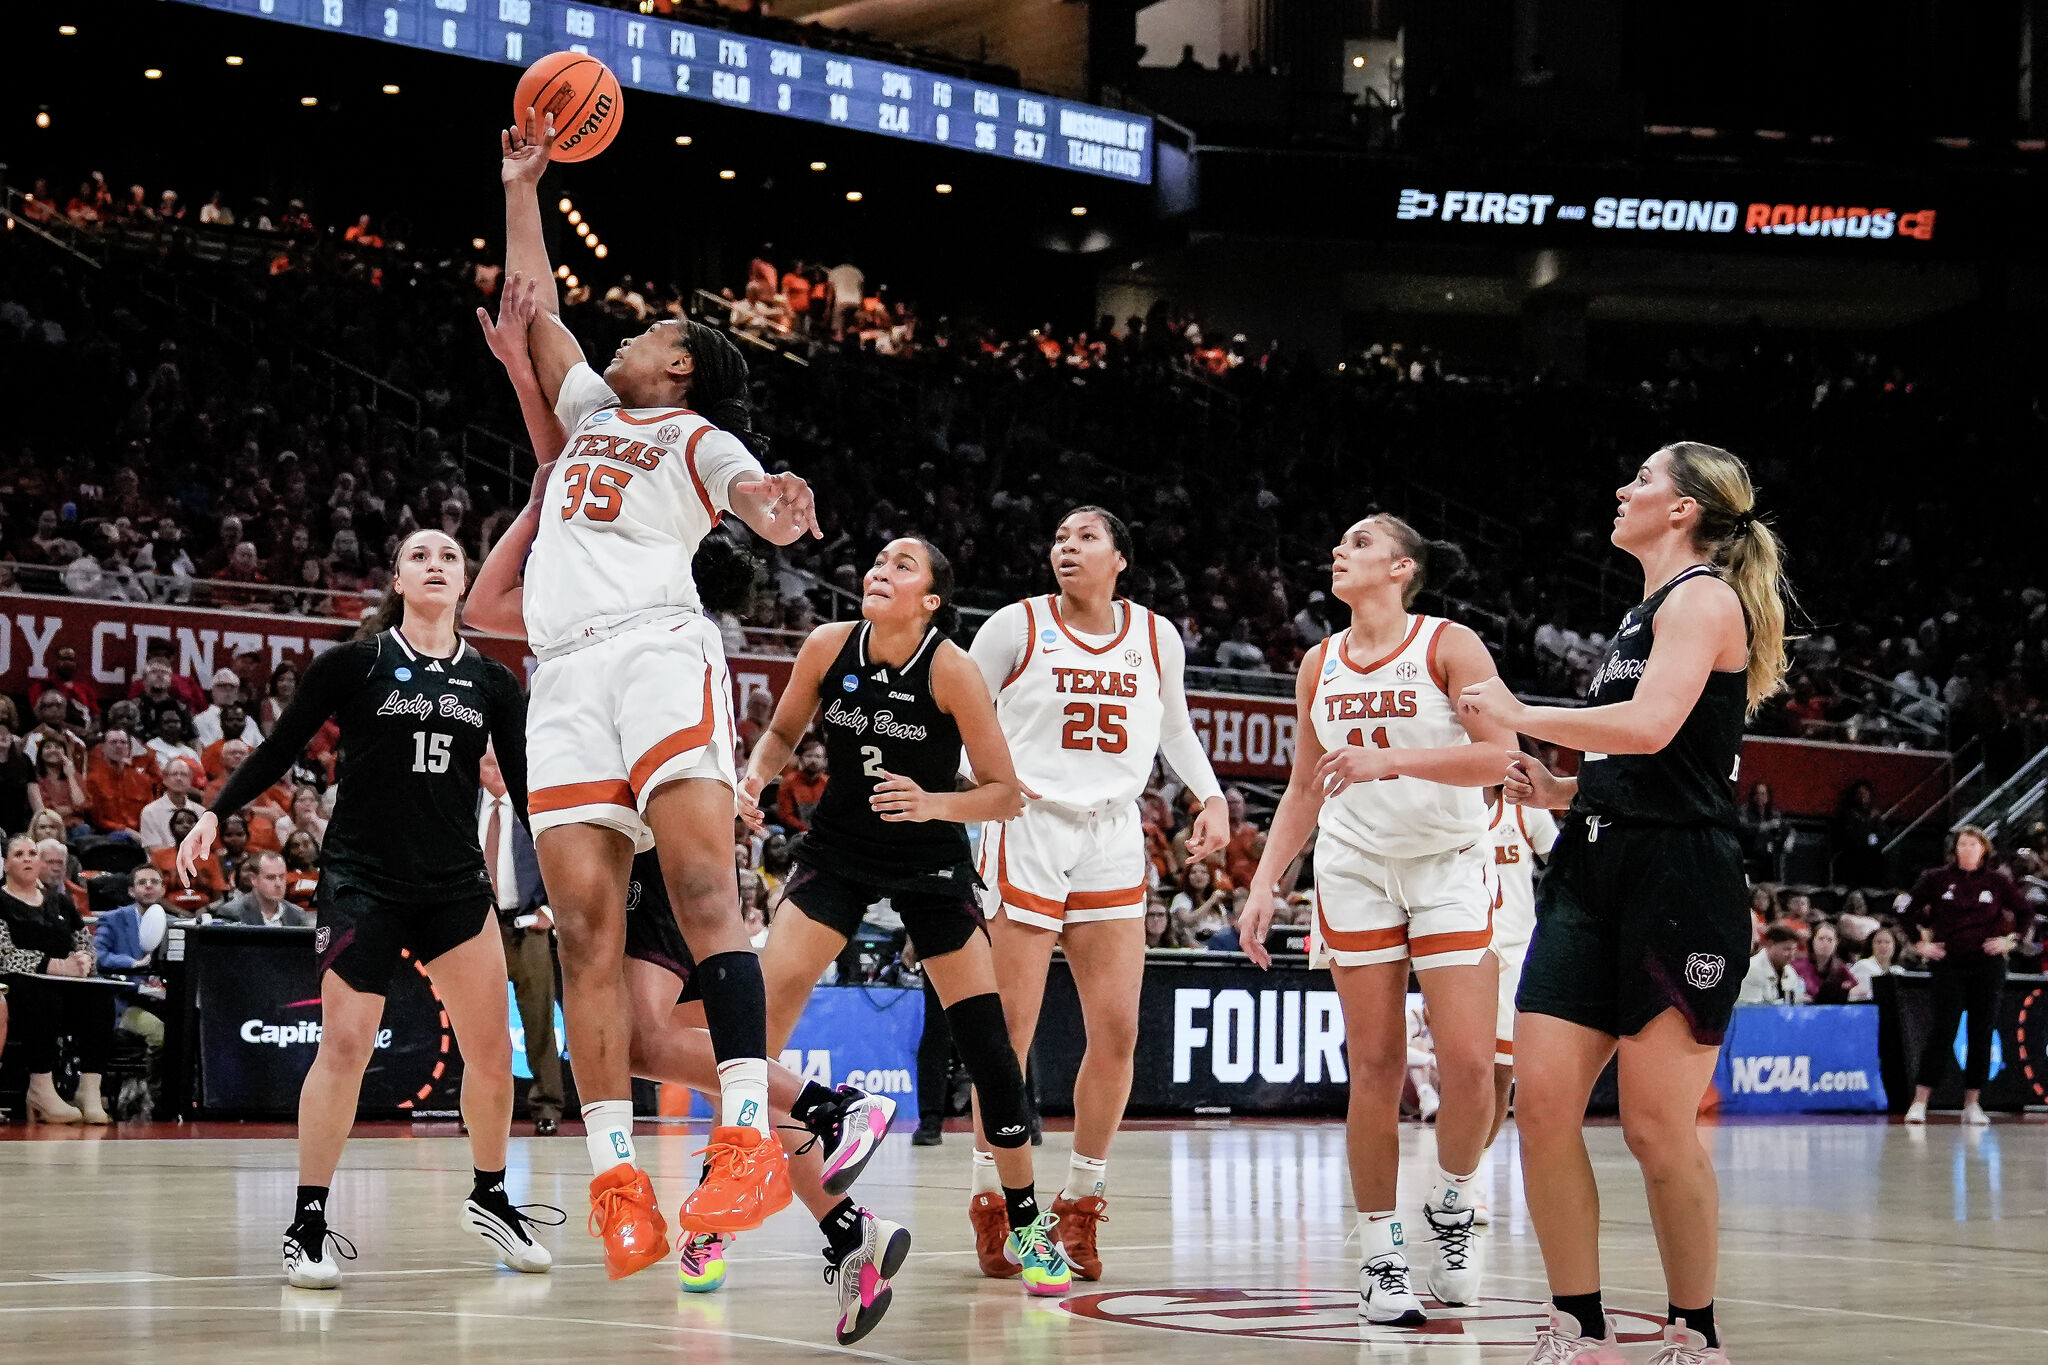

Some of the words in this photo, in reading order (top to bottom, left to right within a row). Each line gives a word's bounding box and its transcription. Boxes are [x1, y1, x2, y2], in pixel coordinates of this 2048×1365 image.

[627, 21, 647, 49] FT
[384, 8, 398, 37] 3
[506, 32, 522, 61] 11
[631, 55, 641, 83] 1
[676, 63, 690, 93] 2
[777, 83, 792, 112] 3
[558, 93, 613, 151] Wilson
[1068, 139, 1103, 169] TEAM
[1102, 146, 1142, 178] STATS
[1441, 190, 1554, 225] FIRST
[1592, 197, 1738, 232] SECOND
[1745, 203, 1897, 239] ROUNDS
[567, 434, 668, 471] TEXAS
[561, 463, 633, 523] 35
[1051, 667, 1138, 698] TEXAS
[376, 689, 433, 721] Lady
[438, 694, 483, 727] Bears
[825, 698, 868, 735] Lady
[873, 710, 927, 740] Bears
[1325, 690, 1417, 722] TEXAS
[1061, 701, 1128, 754] 25
[412, 731, 453, 773] 15
[860, 745, 885, 779] 2
[1173, 988, 1348, 1083] FOUR
[1732, 1055, 1869, 1094] NCAA.com
